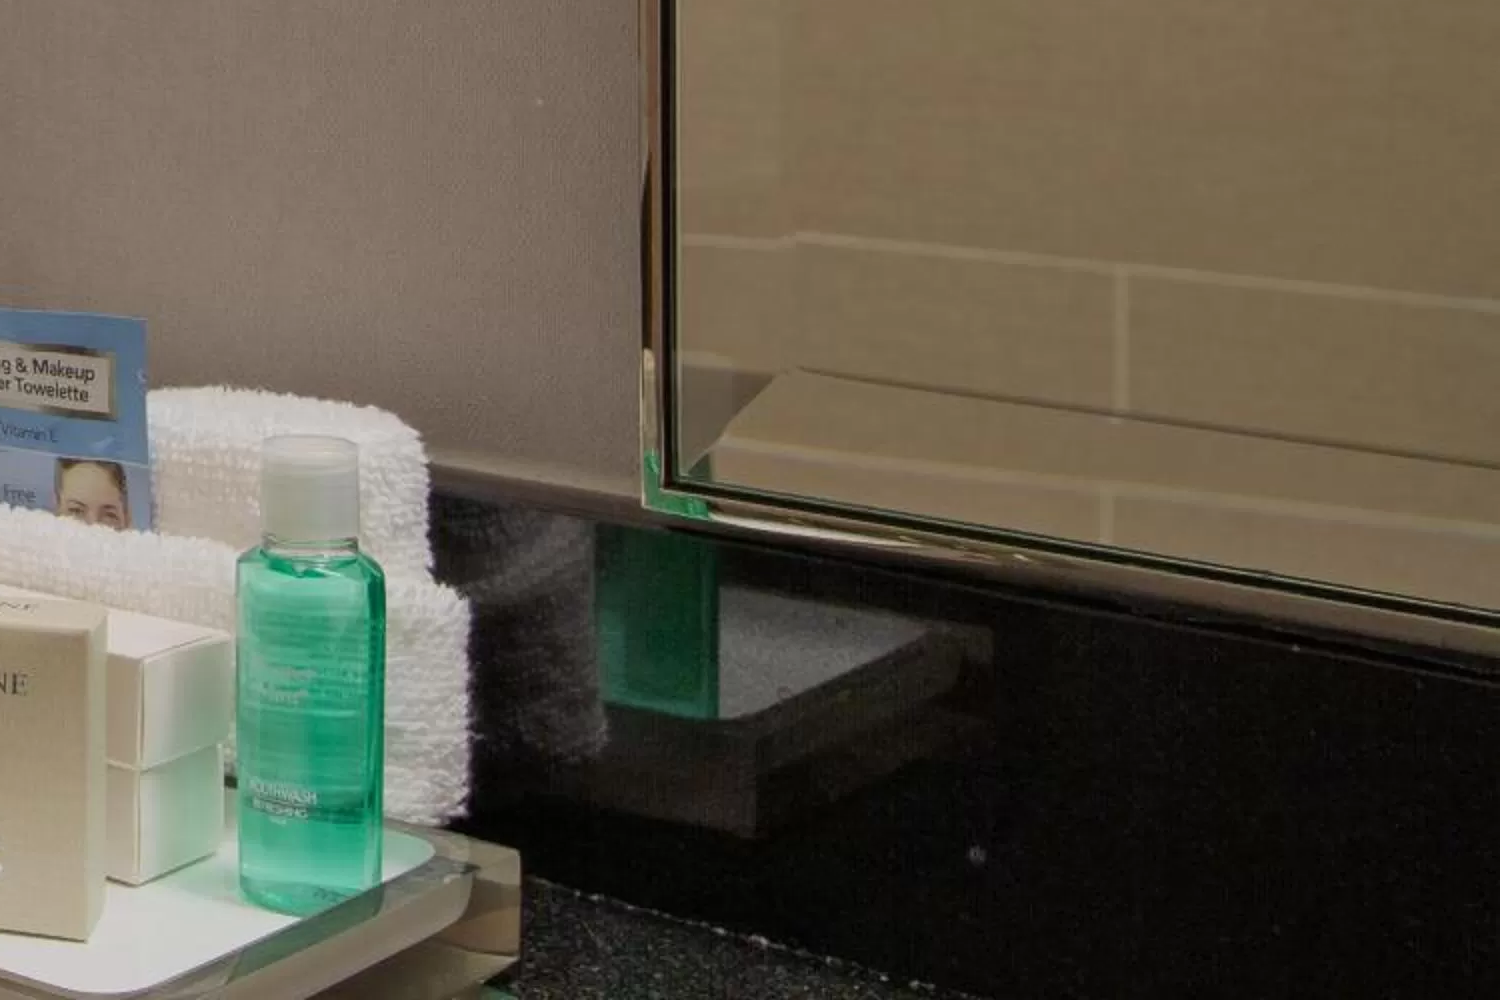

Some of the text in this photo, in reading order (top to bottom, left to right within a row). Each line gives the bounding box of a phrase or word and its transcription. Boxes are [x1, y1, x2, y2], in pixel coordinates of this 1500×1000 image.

[15, 357, 28, 374] &
[33, 357, 96, 385] Makeup
[14, 376, 90, 403] Towelette
